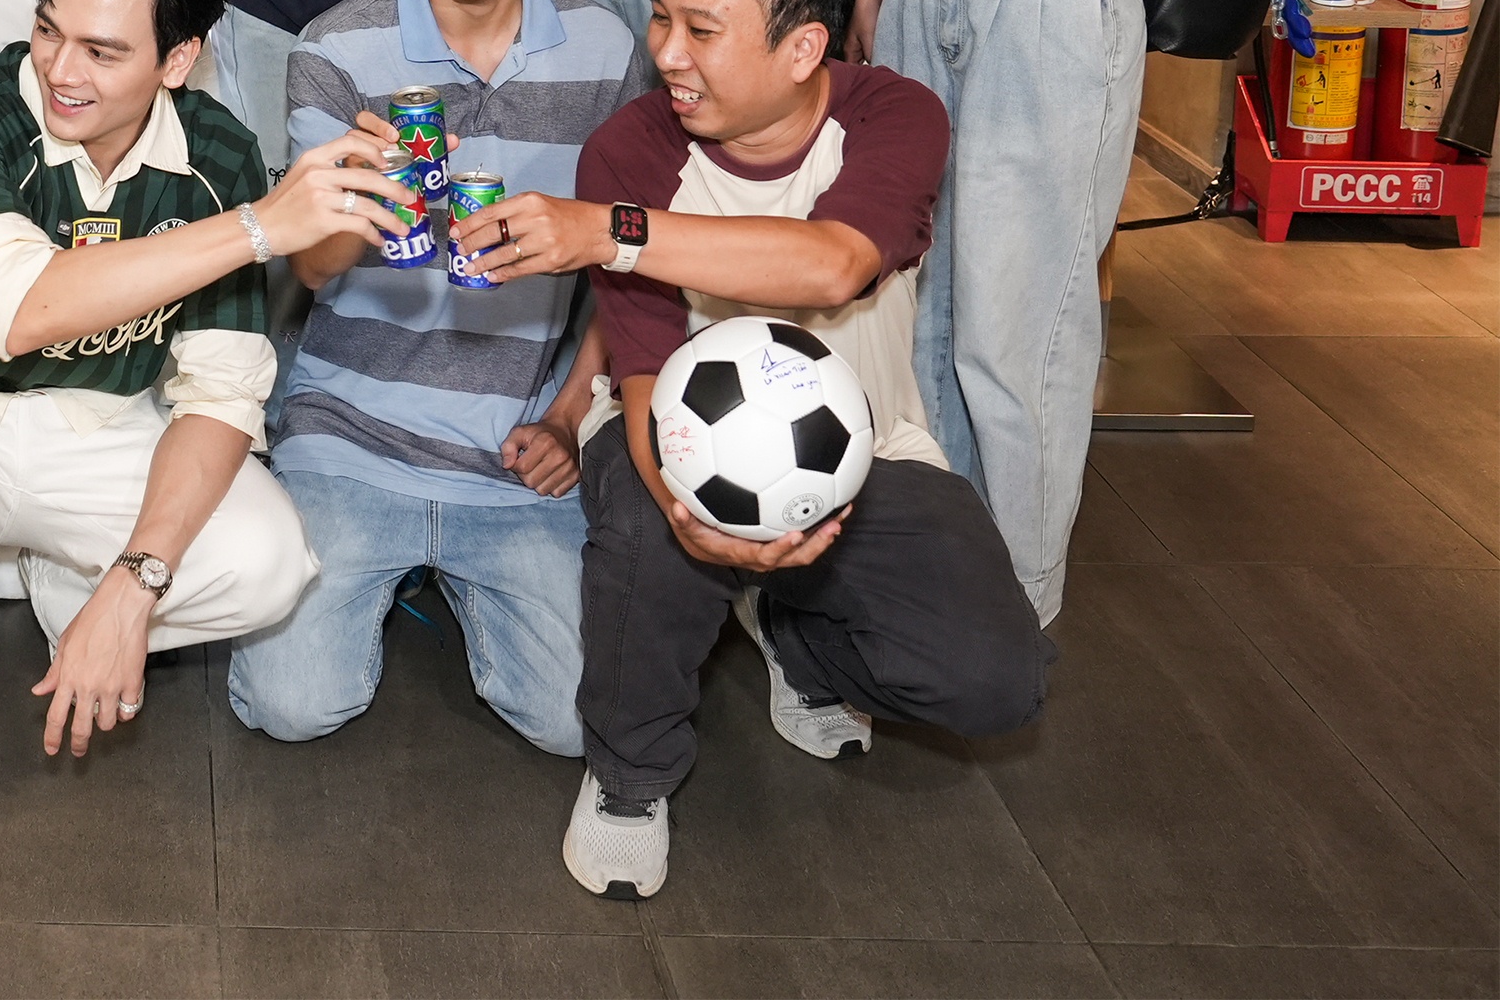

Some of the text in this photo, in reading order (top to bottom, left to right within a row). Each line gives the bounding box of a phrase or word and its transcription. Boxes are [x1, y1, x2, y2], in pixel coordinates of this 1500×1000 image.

[413, 114, 427, 123] 0.0
[1311, 173, 1401, 203] PCCC
[77, 222, 116, 236] MCMIII
